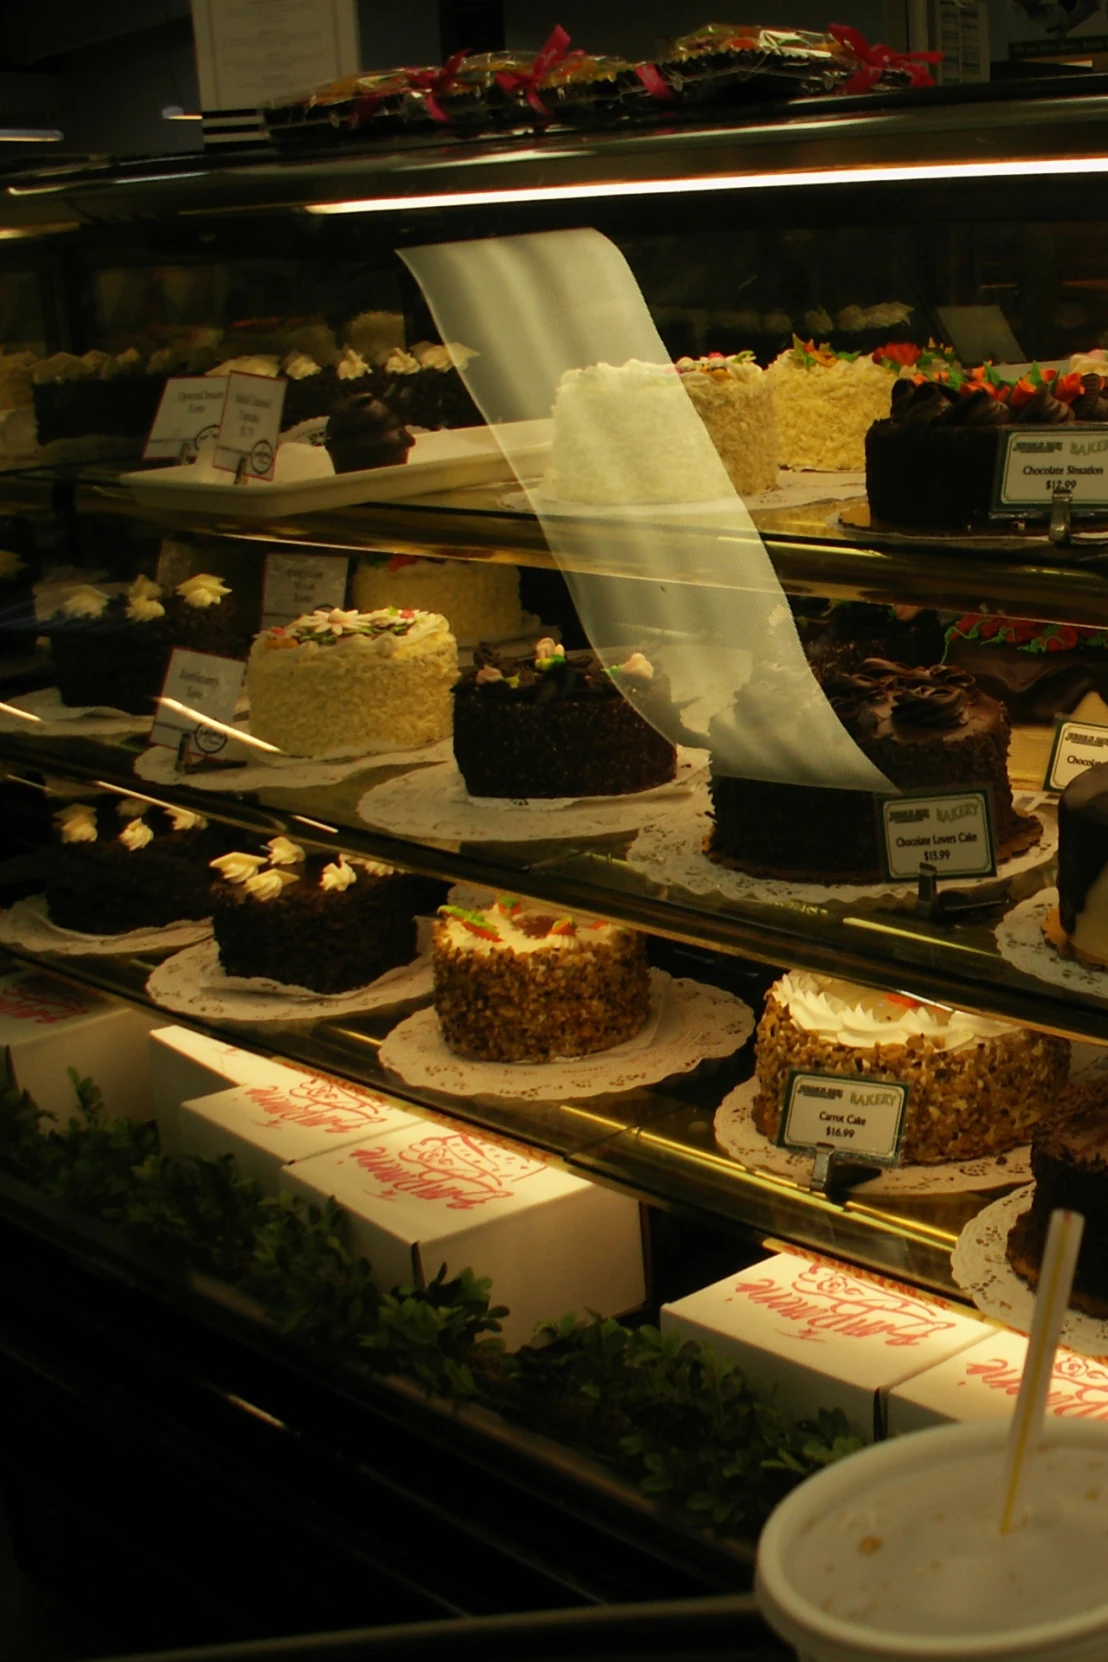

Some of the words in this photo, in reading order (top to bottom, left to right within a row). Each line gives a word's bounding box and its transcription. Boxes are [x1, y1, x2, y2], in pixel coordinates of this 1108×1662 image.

[1023, 465, 1064, 475] Chocolate
[1046, 480, 1077, 490] $12.99
[936, 803, 979, 823] BAKERY
[896, 836, 931, 847] Chocolate
[933, 834, 956, 845] Lovers
[958, 832, 978, 842] Cake
[924, 850, 951, 861] $15.99
[850, 1091, 896, 1107] BAKERY
[819, 1111, 844, 1123] Carrot
[846, 1114, 866, 1126] Cake
[826, 1126, 855, 1138] $16.99
